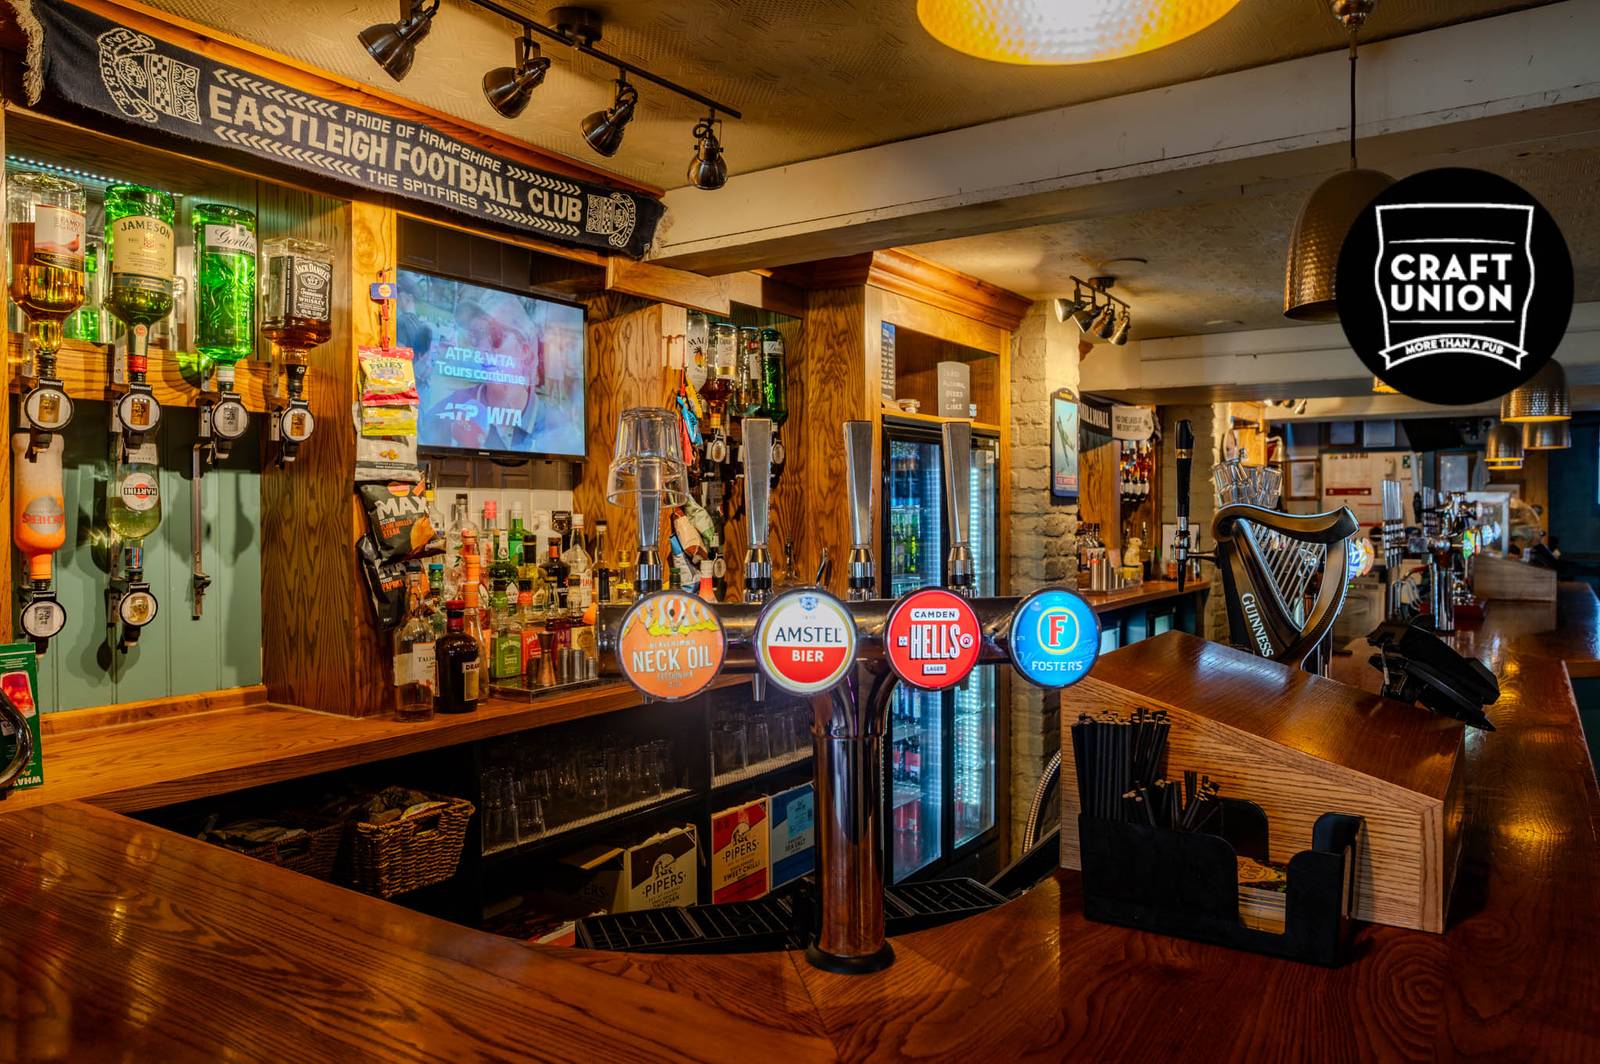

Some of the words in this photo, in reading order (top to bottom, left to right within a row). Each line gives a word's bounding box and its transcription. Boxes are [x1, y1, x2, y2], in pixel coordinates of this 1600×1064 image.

[345, 110, 391, 133] PRIDE
[396, 124, 415, 138] OF
[419, 129, 501, 173] HAMPSHIRE
[208, 85, 388, 168] EASTLEIGH
[394, 140, 522, 208] FOOTBALL
[527, 188, 583, 223] CLUB
[367, 169, 398, 188] THE
[403, 177, 478, 210] SPITFIRES
[120, 219, 171, 240] JAMESON
[436, 361, 473, 378] Tours
[445, 347, 472, 361] ATP
[473, 350, 484, 364] &
[485, 352, 515, 368] WTA
[438, 402, 479, 421] ATP
[487, 406, 523, 426] WTA
[124, 487, 157, 495] MARTINI
[374, 496, 429, 520] MAX
[913, 610, 956, 619] CAMDEN
[1241, 592, 1275, 658] GUINNESS
[775, 626, 842, 643] AMSTEL
[910, 623, 961, 660] HELLS
[1048, 614, 1068, 647] F
[632, 648, 681, 673] NECK
[687, 645, 714, 669] OIL
[791, 649, 825, 662] BIER
[725, 839, 757, 863] PIPERS
[645, 871, 684, 898] PIPERS
